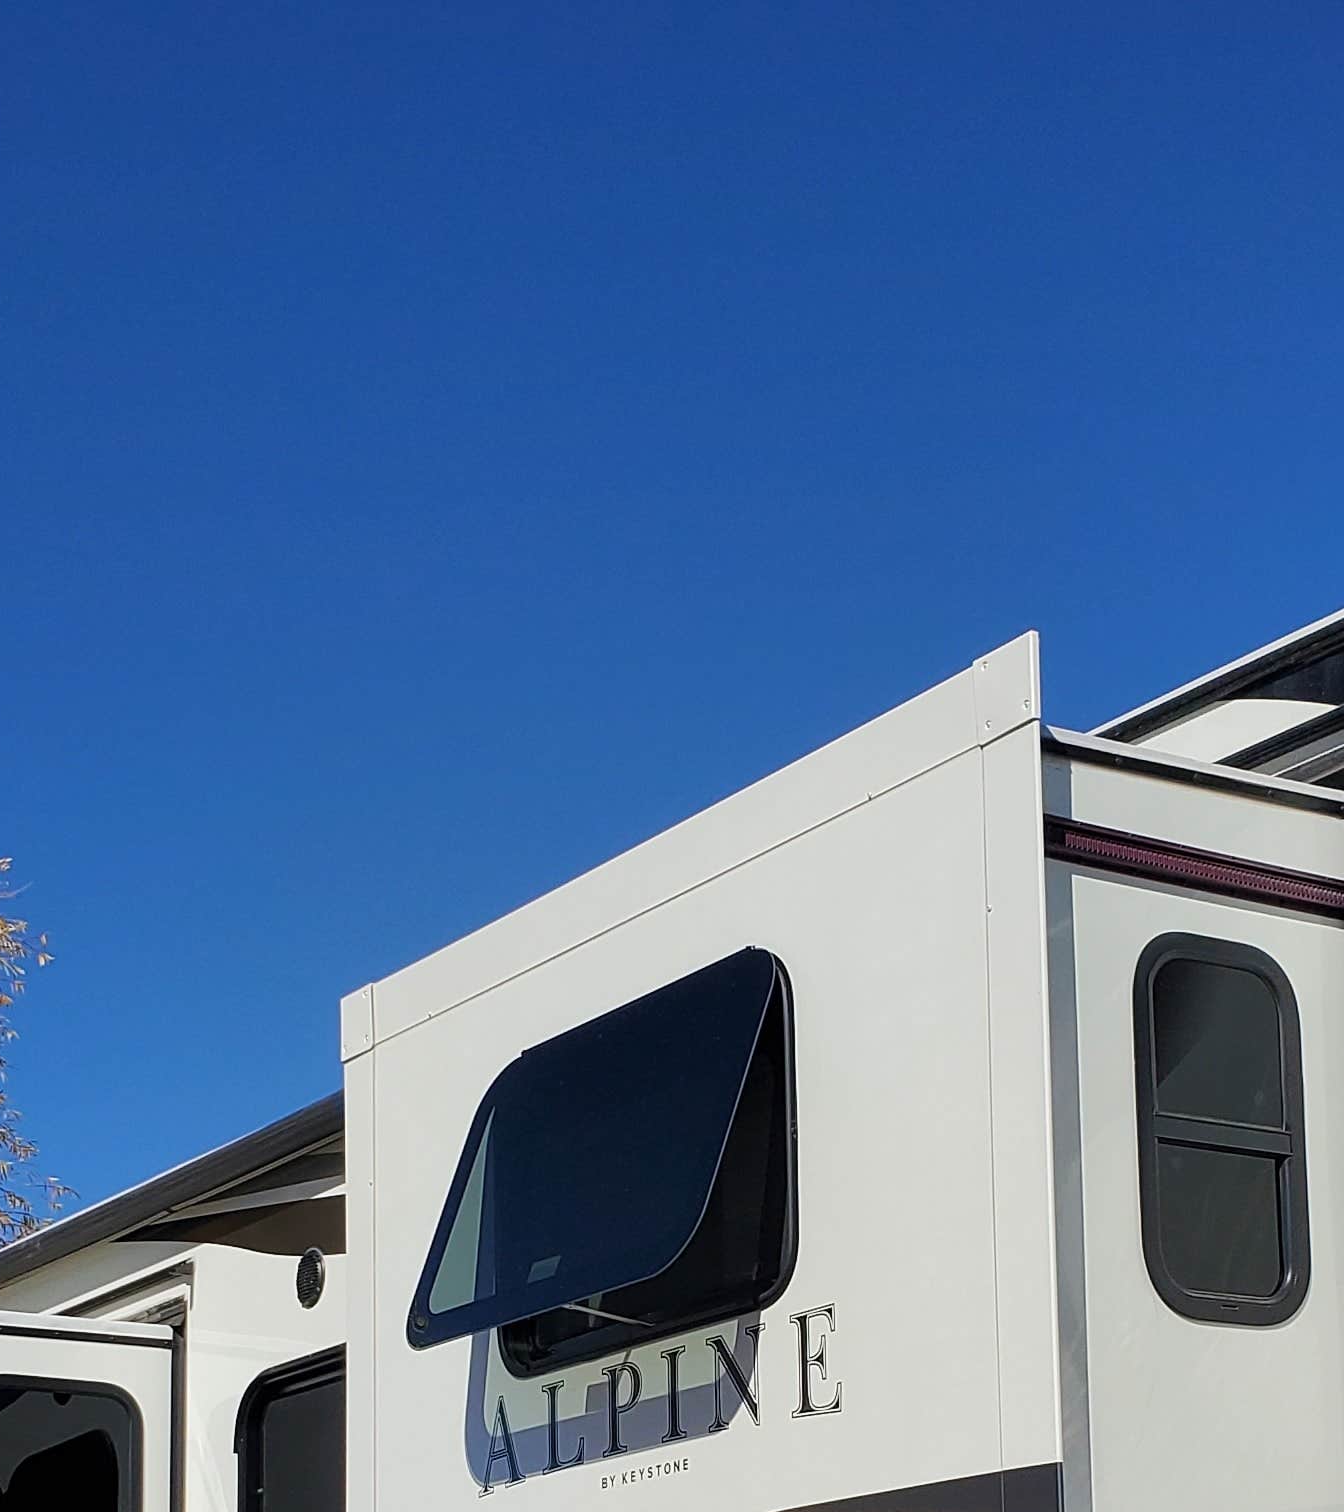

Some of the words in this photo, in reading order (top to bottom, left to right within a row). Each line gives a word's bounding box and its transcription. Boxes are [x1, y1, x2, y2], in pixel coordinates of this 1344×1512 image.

[478, 1303, 843, 1498] ALPINE
[601, 1474, 616, 1489] BY
[621, 1458, 689, 1485] KEYSTONE
